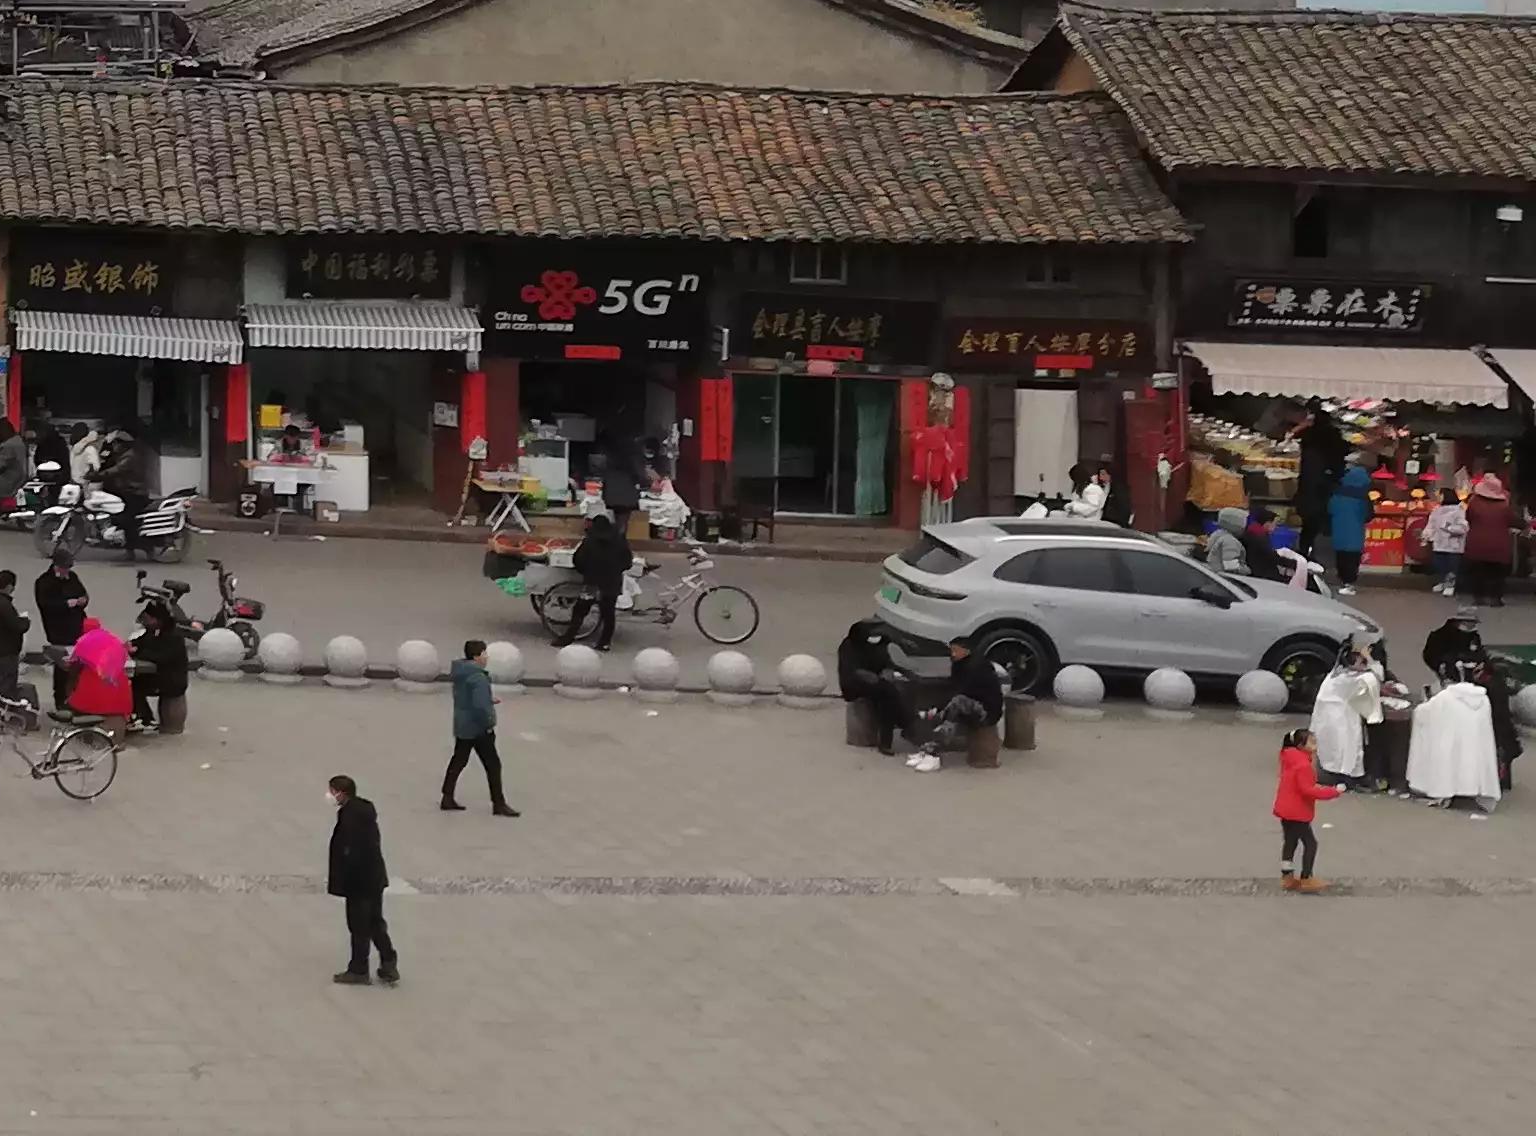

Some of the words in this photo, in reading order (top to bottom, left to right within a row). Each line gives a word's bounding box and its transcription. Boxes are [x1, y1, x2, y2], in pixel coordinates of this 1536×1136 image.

[29, 259, 160, 295] 昭盛银饰
[300, 248, 439, 282] 中国福利彩票
